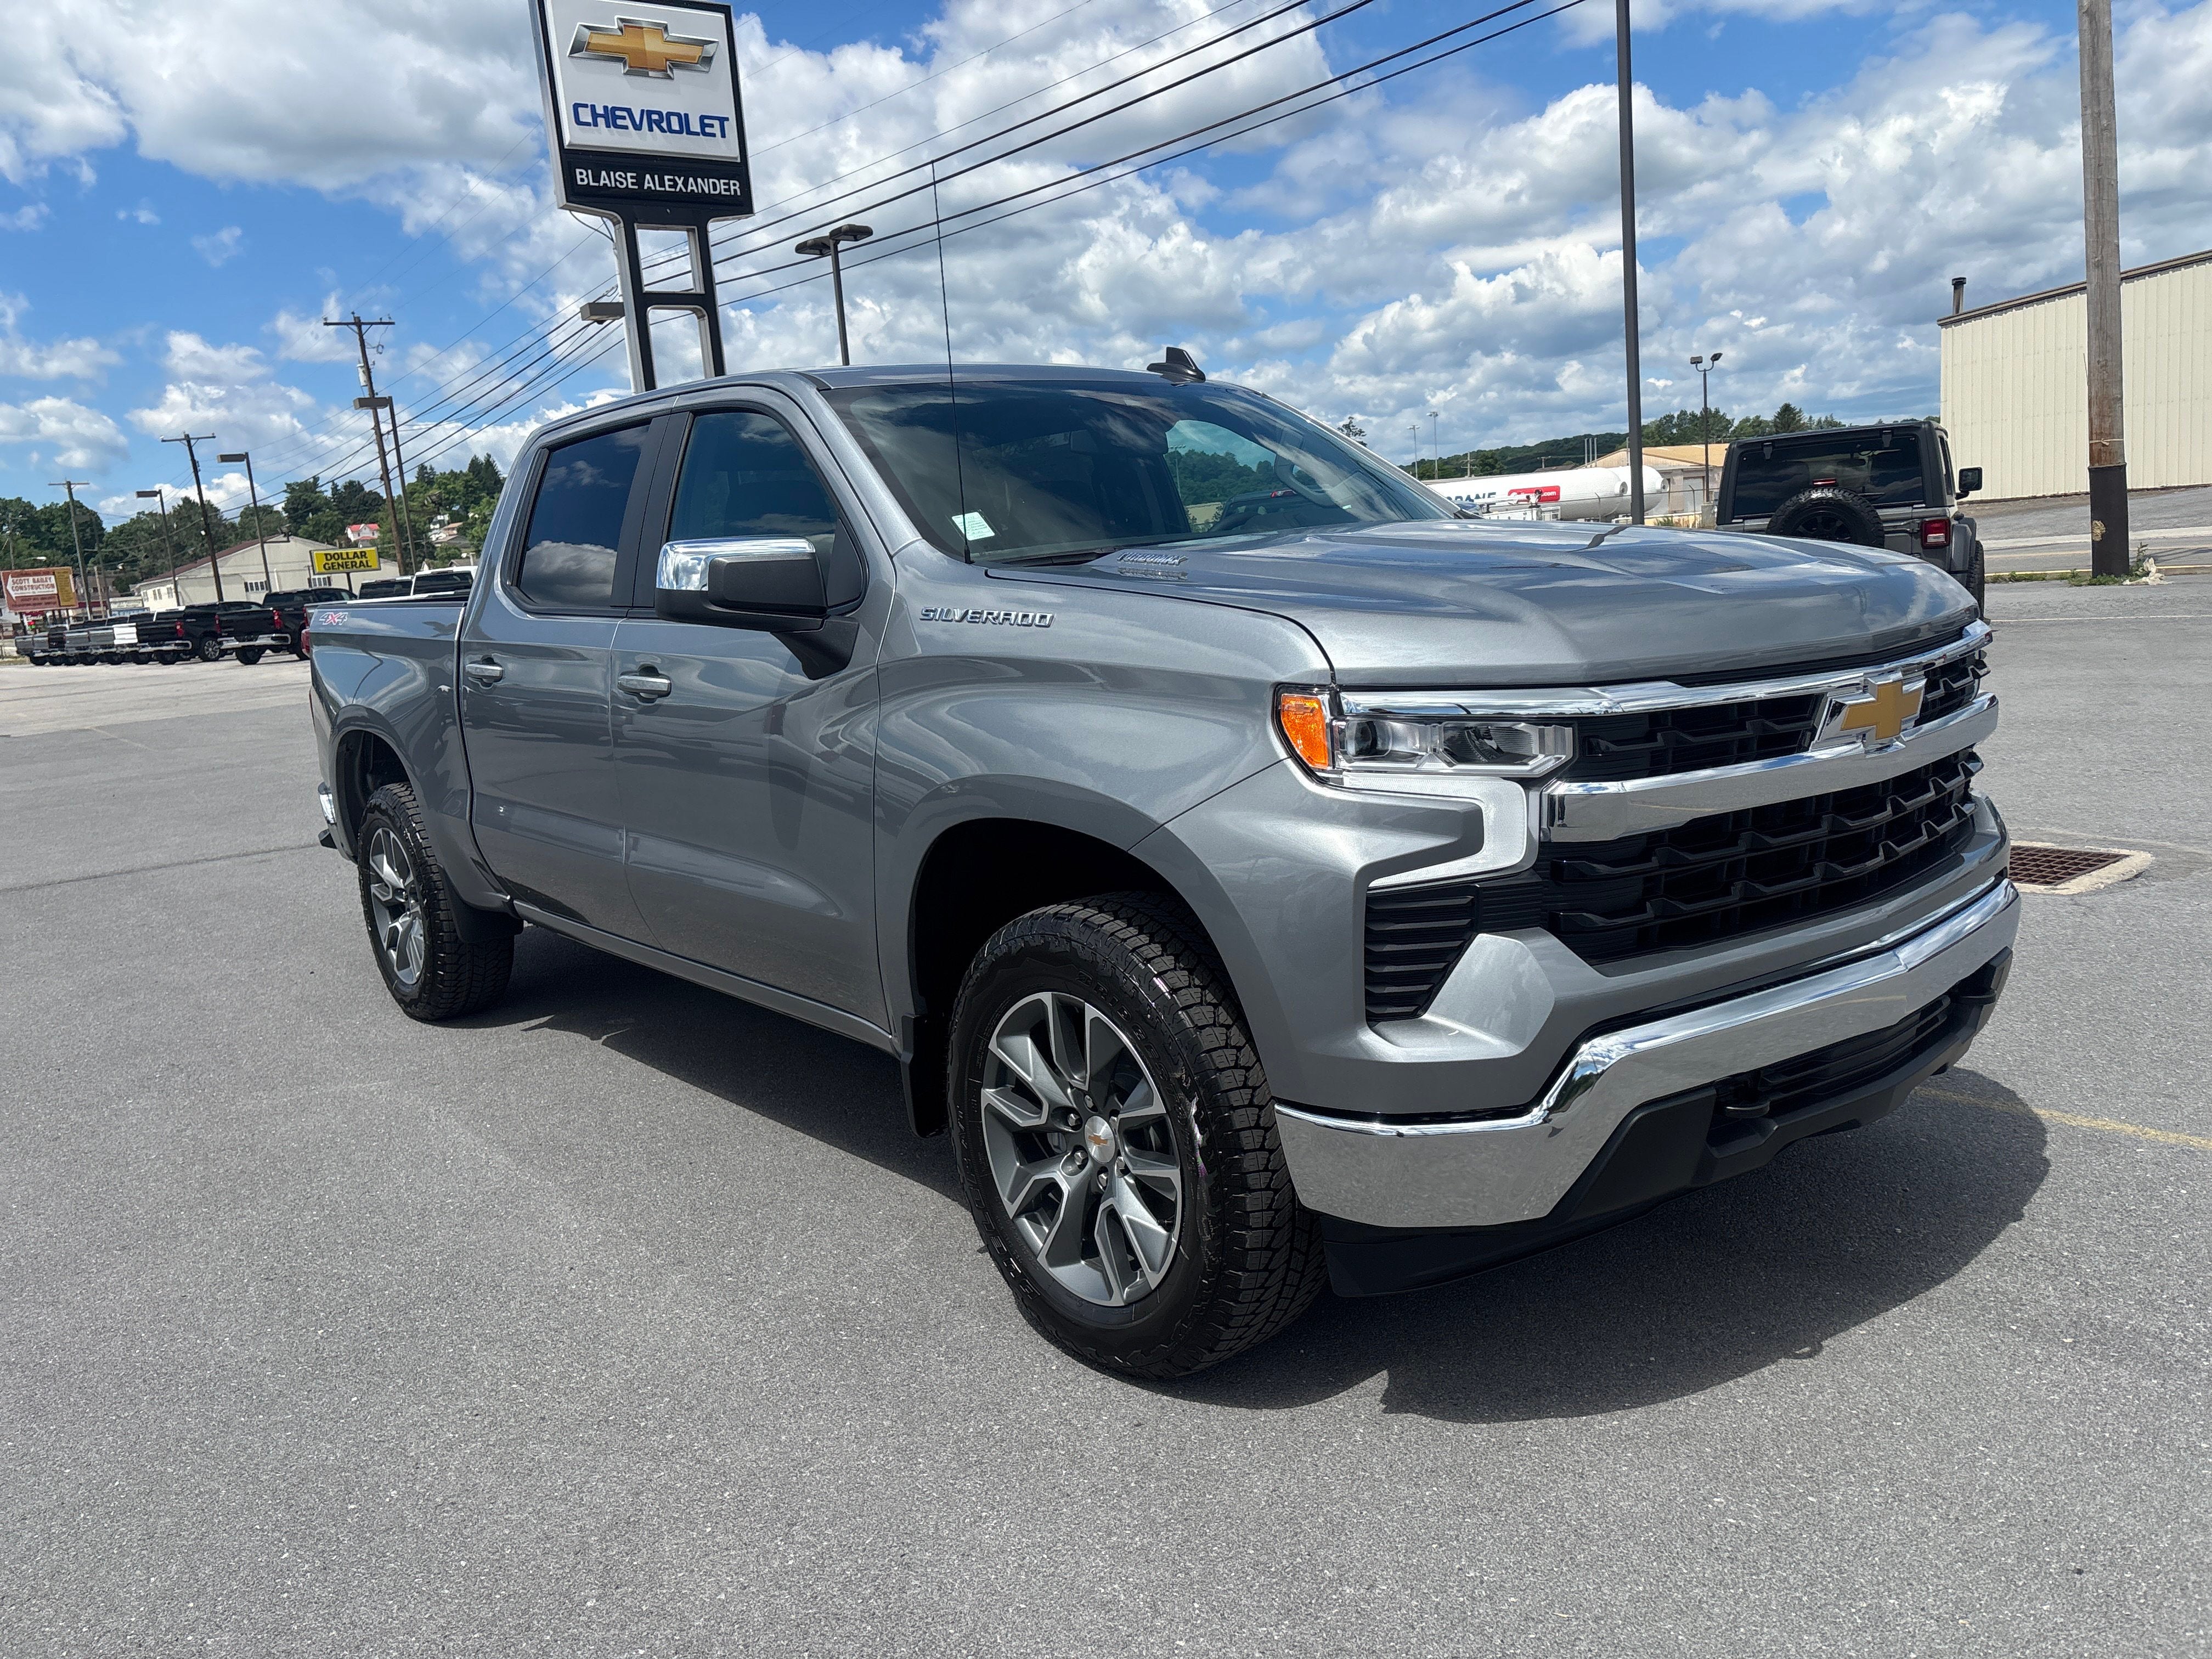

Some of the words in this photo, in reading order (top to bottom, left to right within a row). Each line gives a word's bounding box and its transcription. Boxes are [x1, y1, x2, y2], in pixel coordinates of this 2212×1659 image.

[572, 102, 730, 139] CHEVROLET
[575, 168, 639, 190] BLAISE
[644, 173, 741, 196] ALEXANDER
[324, 550, 368, 561] DOLLAR
[323, 560, 372, 571] GENERAL
[11, 583, 55, 592] CONSTRUCTION
[919, 606, 1056, 628] SILVERADO
